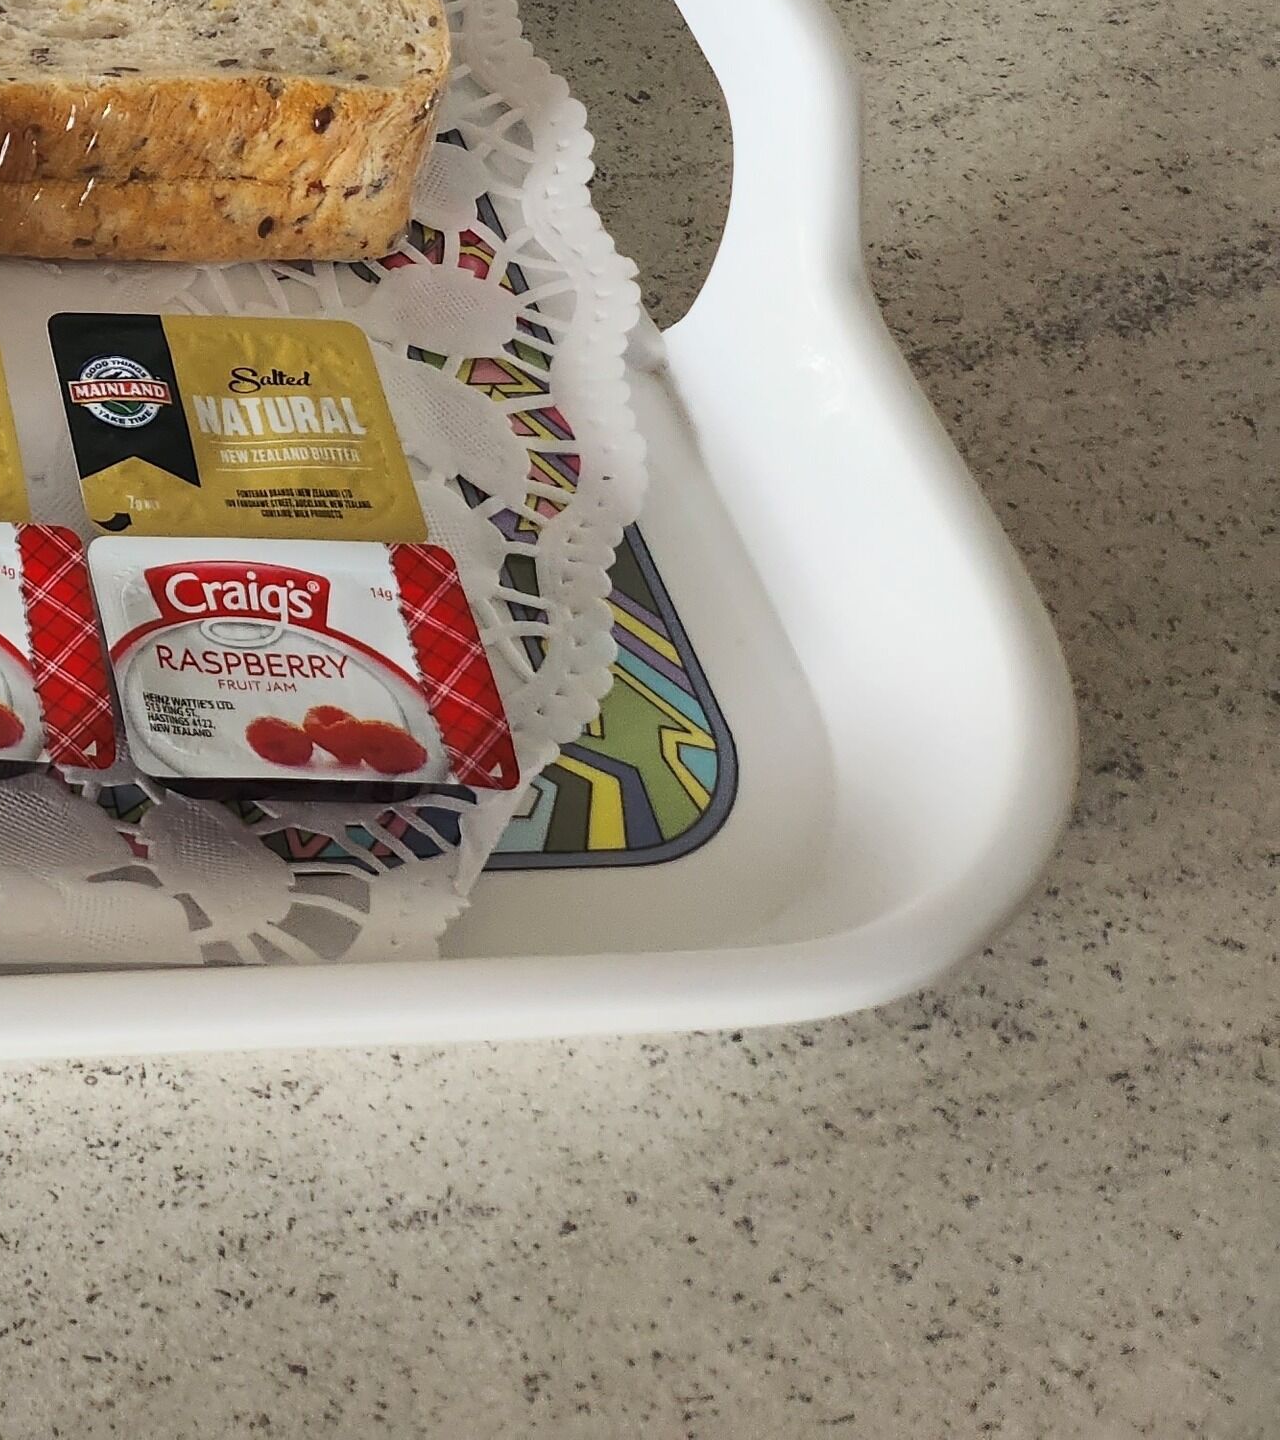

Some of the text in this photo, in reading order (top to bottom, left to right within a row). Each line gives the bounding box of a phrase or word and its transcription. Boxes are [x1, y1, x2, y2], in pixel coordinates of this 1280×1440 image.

[85, 360, 148, 378] GOOD THINGS
[228, 367, 312, 394] Salted
[73, 382, 166, 398] MAINLAND
[99, 409, 126, 424] TAKE
[192, 394, 368, 436] NATURAL
[220, 446, 361, 463] NEW ZEALAND BUTTER
[369, 586, 393, 601] 14g
[156, 645, 349, 679] RASPBERRY
[218, 679, 298, 693] FRUIT JAM
